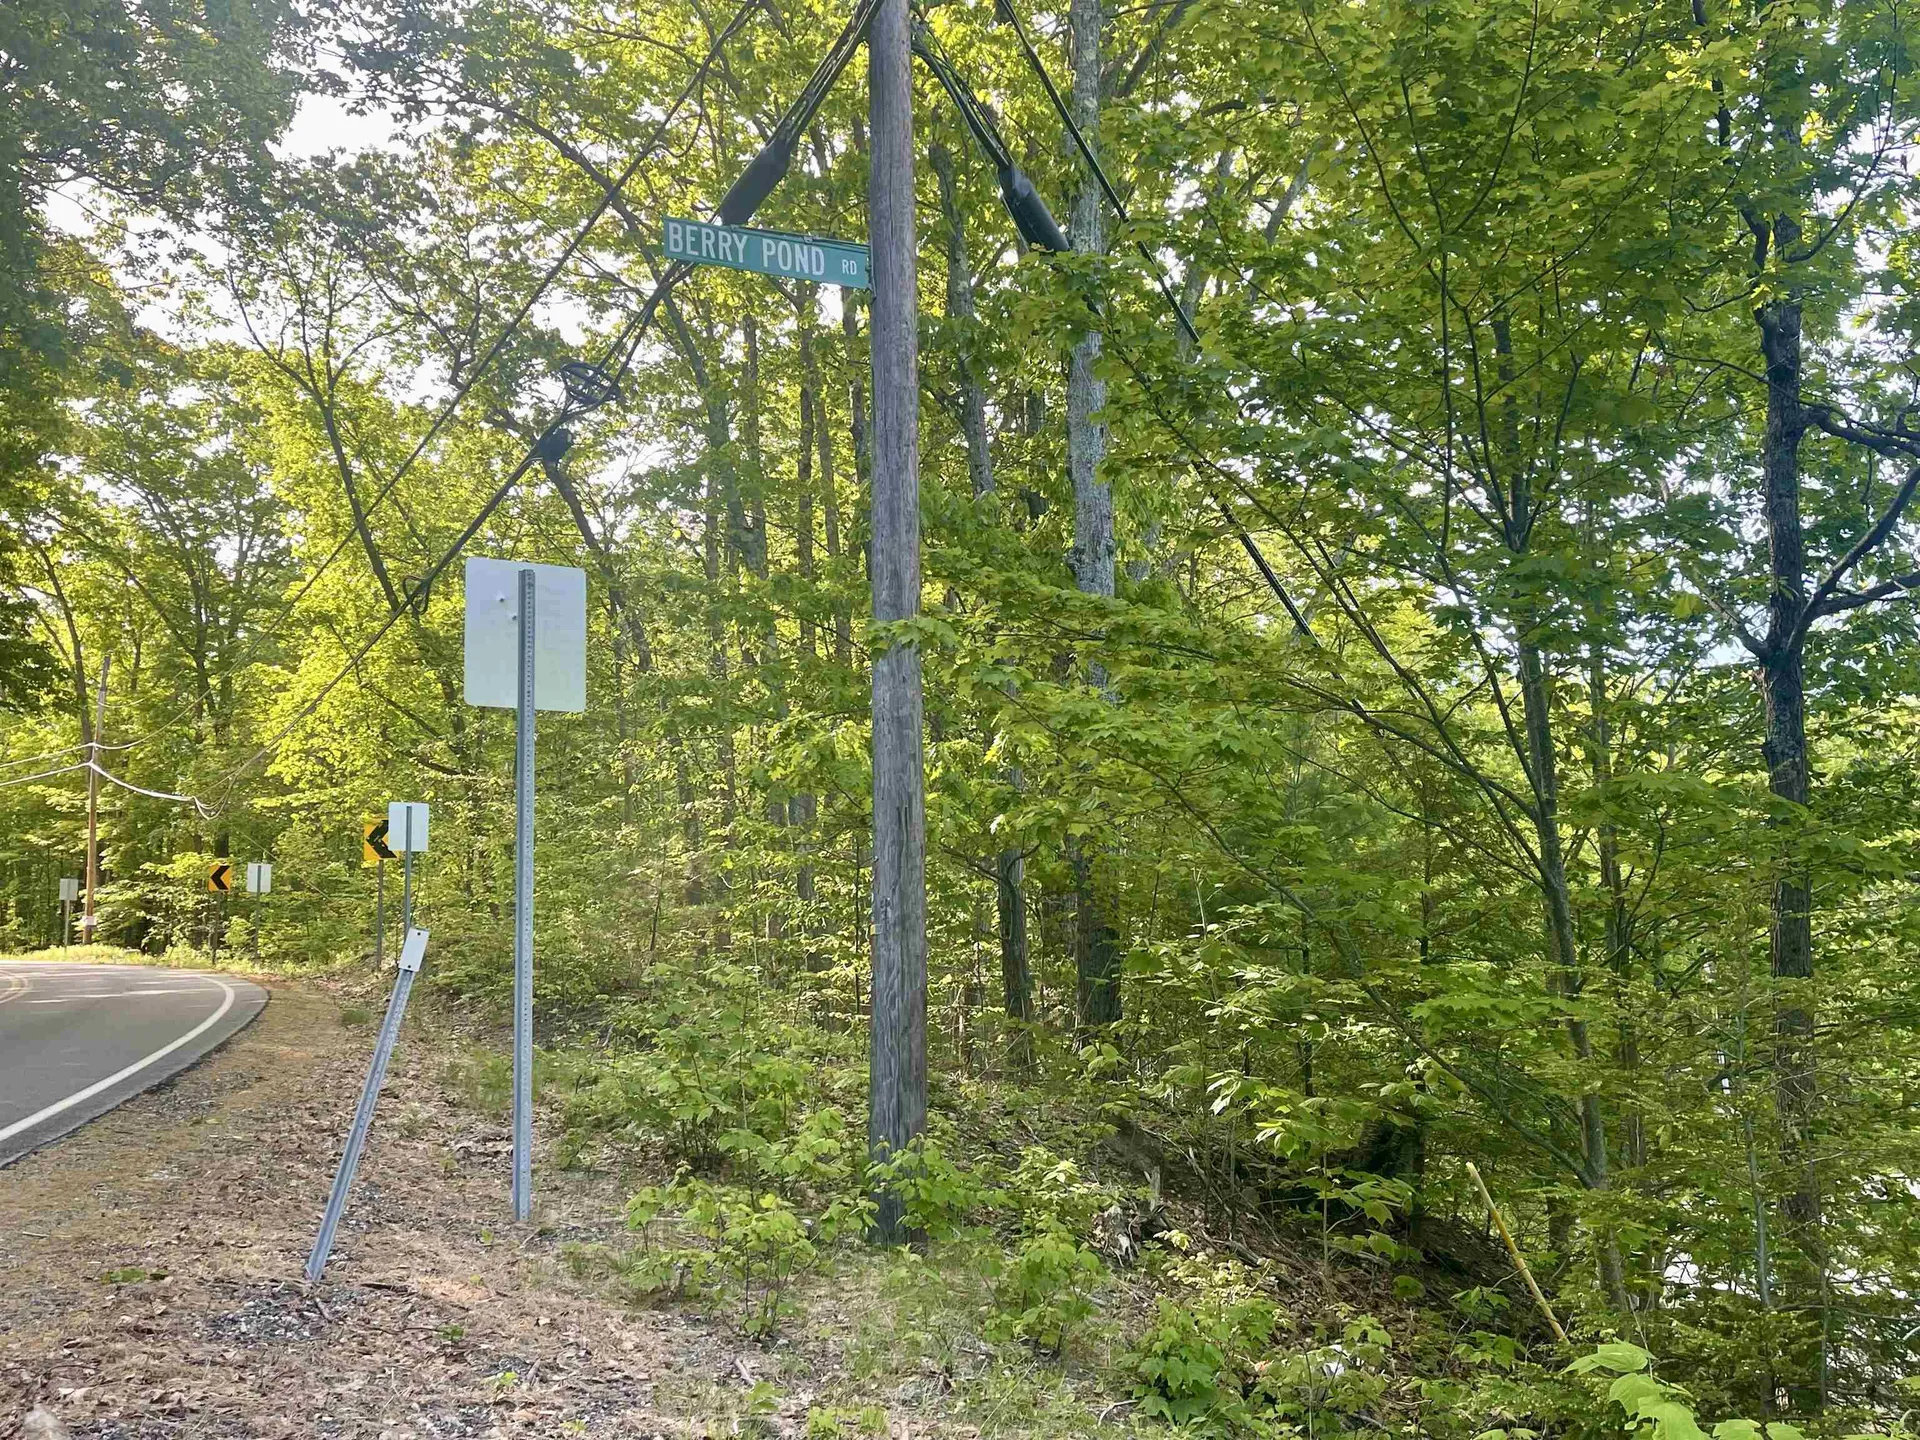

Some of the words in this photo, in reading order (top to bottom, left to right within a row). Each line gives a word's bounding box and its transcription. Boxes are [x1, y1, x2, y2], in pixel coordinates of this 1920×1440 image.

[668, 222, 748, 263] BERRY
[762, 238, 825, 276] POND
[842, 259, 857, 275] RD
